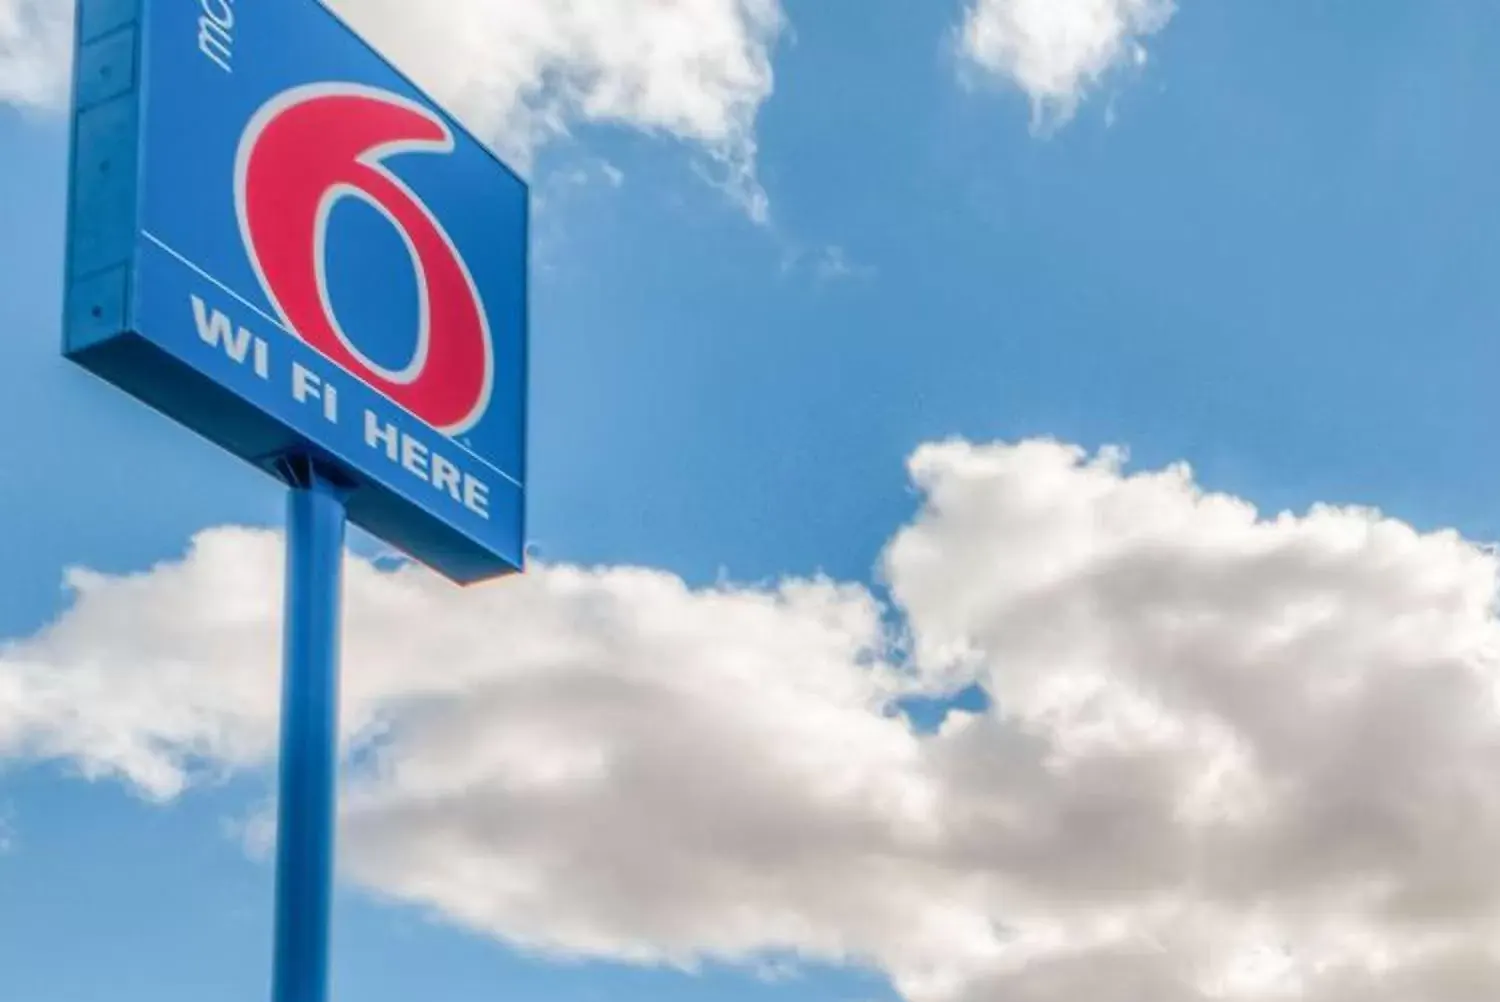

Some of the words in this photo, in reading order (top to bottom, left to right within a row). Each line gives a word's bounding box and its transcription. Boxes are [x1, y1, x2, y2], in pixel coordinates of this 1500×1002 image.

[198, 0, 235, 73] mo
[233, 81, 494, 437] 6
[190, 295, 268, 379] WI
[292, 361, 337, 423] FI
[364, 409, 489, 520] HERE
